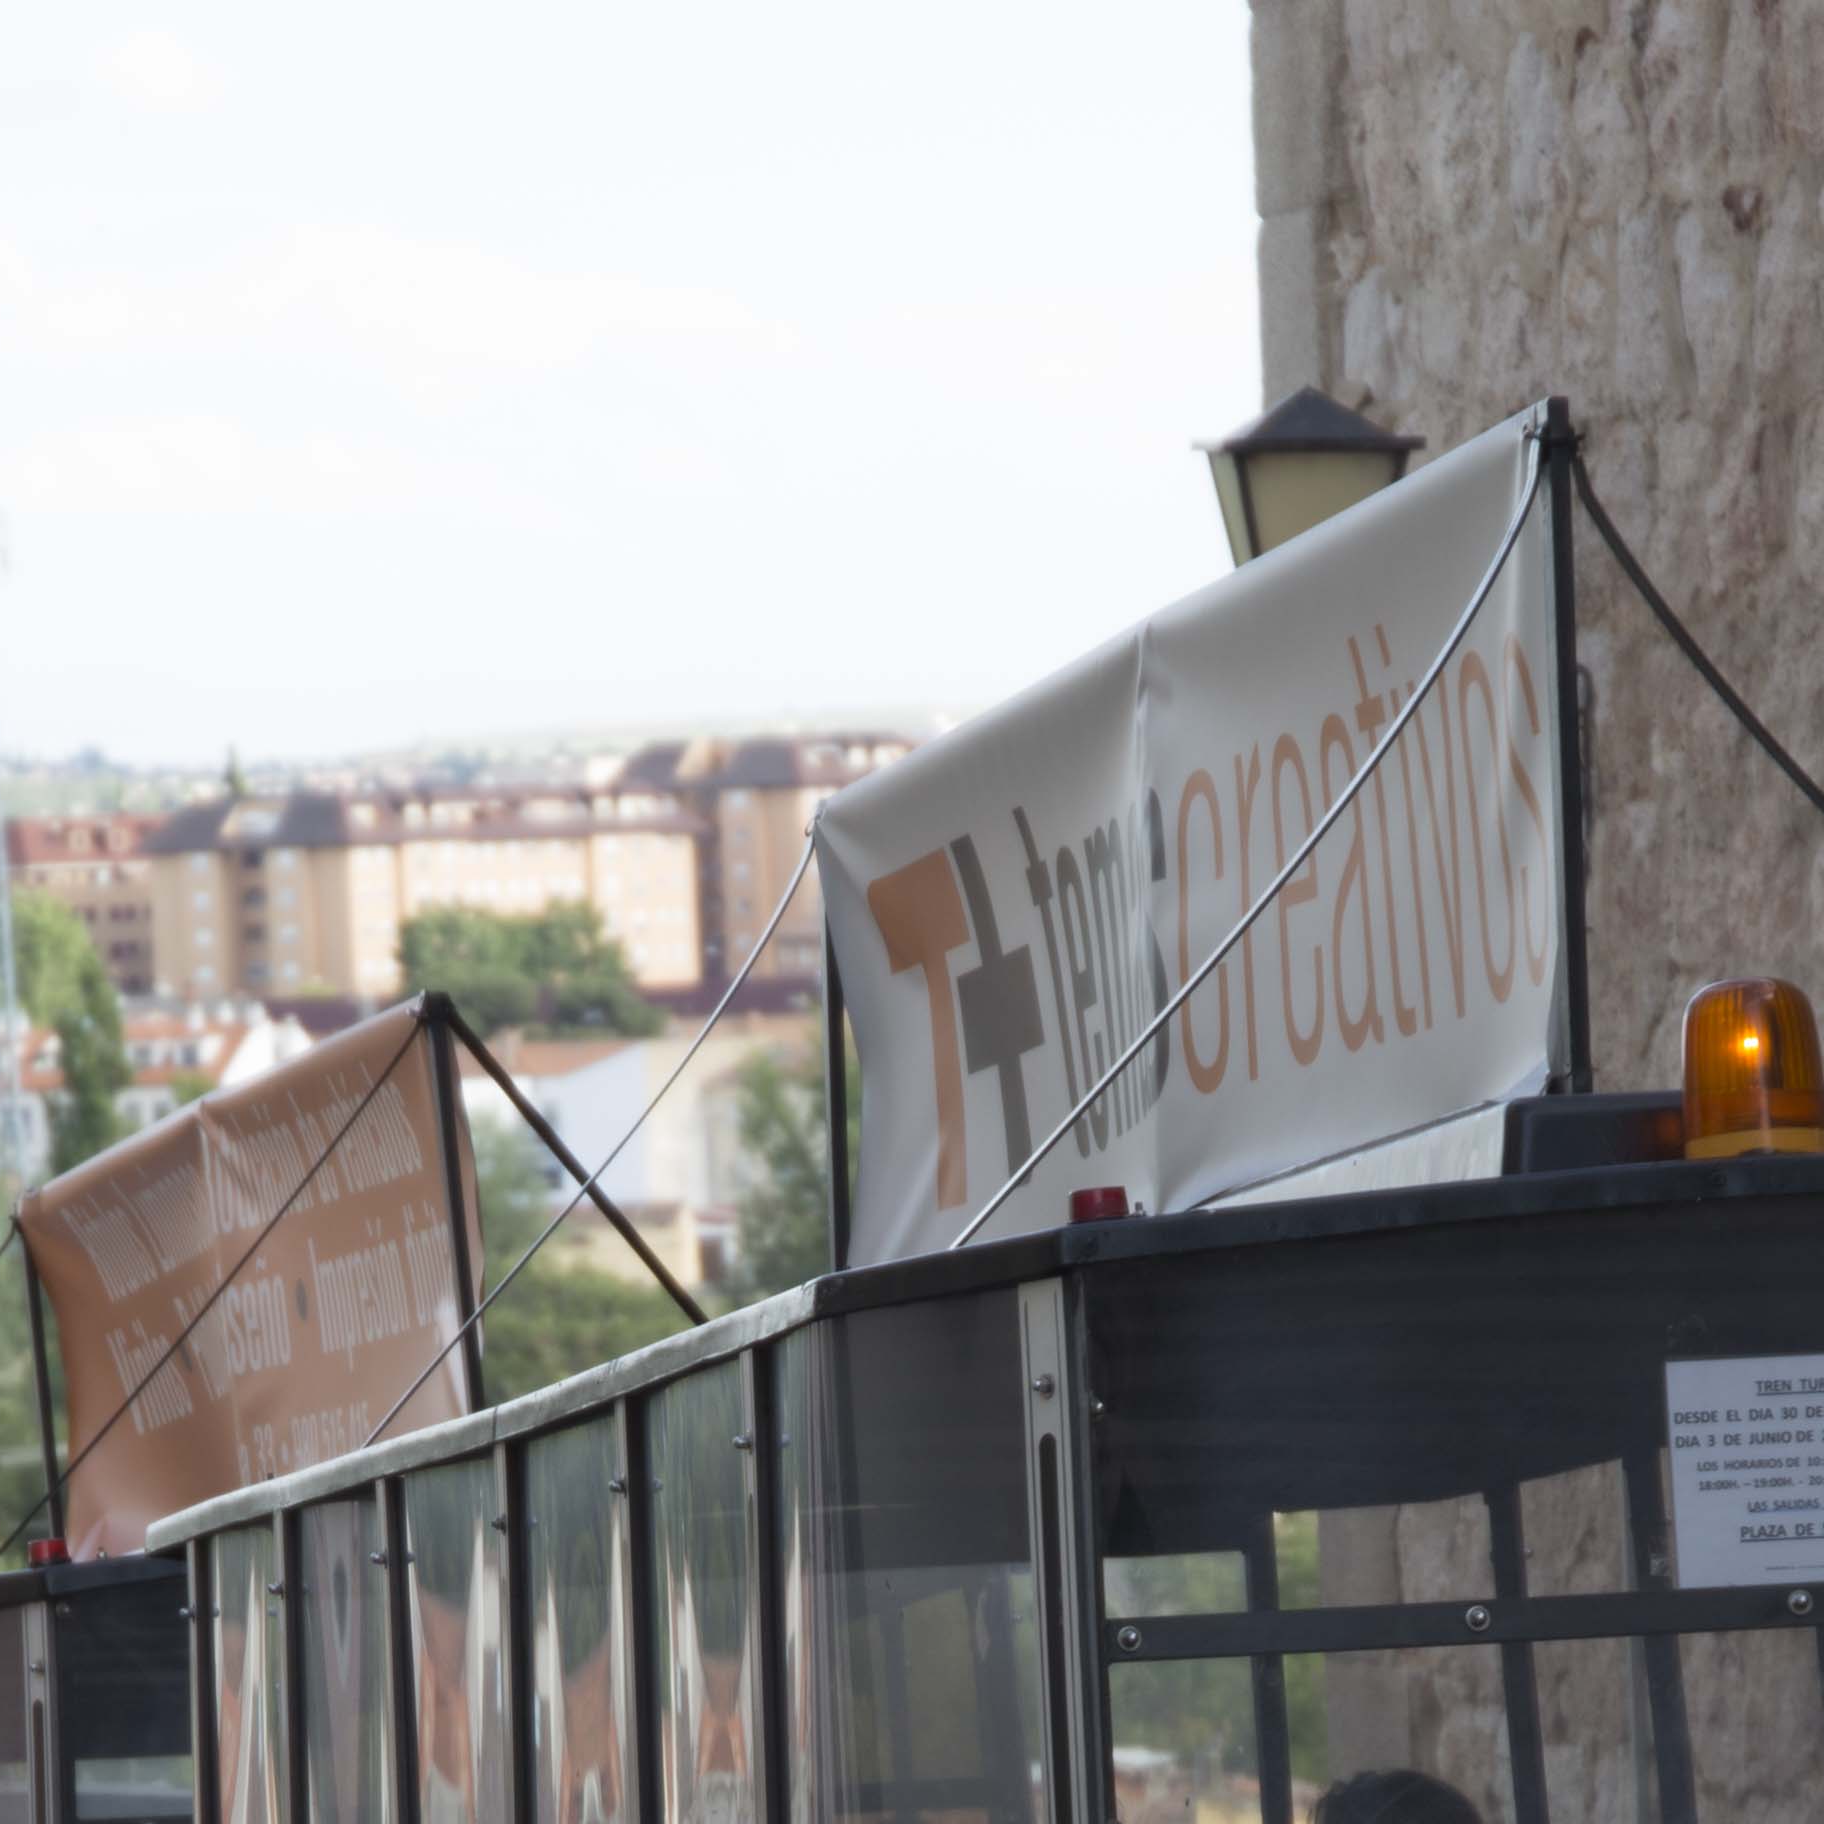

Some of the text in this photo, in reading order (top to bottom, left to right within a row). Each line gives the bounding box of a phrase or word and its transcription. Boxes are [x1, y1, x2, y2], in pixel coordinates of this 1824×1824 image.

[307, 1216, 410, 1375] Impresión
[1755, 1378, 1792, 1393] TREN
[1674, 1411, 1719, 1425] DESDE
[1727, 1410, 1742, 1422] EL
[1749, 1408, 1774, 1421] DIA
[1781, 1407, 1798, 1420] 30
[1805, 1406, 1824, 1419] DE
[1675, 1434, 1700, 1448] DIA
[1708, 1434, 1715, 1447] 3
[1723, 1433, 1742, 1446] DE
[1749, 1430, 1792, 1445] JUNIO
[1796, 1430, 1814, 1443] DE
[1697, 1460, 1718, 1472] LOS
[1724, 1457, 1783, 1470] HORARIOS
[1783, 1456, 1801, 1468] DE
[1748, 1500, 1771, 1512] LAS
[1773, 1498, 1820, 1511] SALIDAS
[1740, 1524, 1787, 1540] PLAZA
[1795, 1522, 1815, 1536] DE
